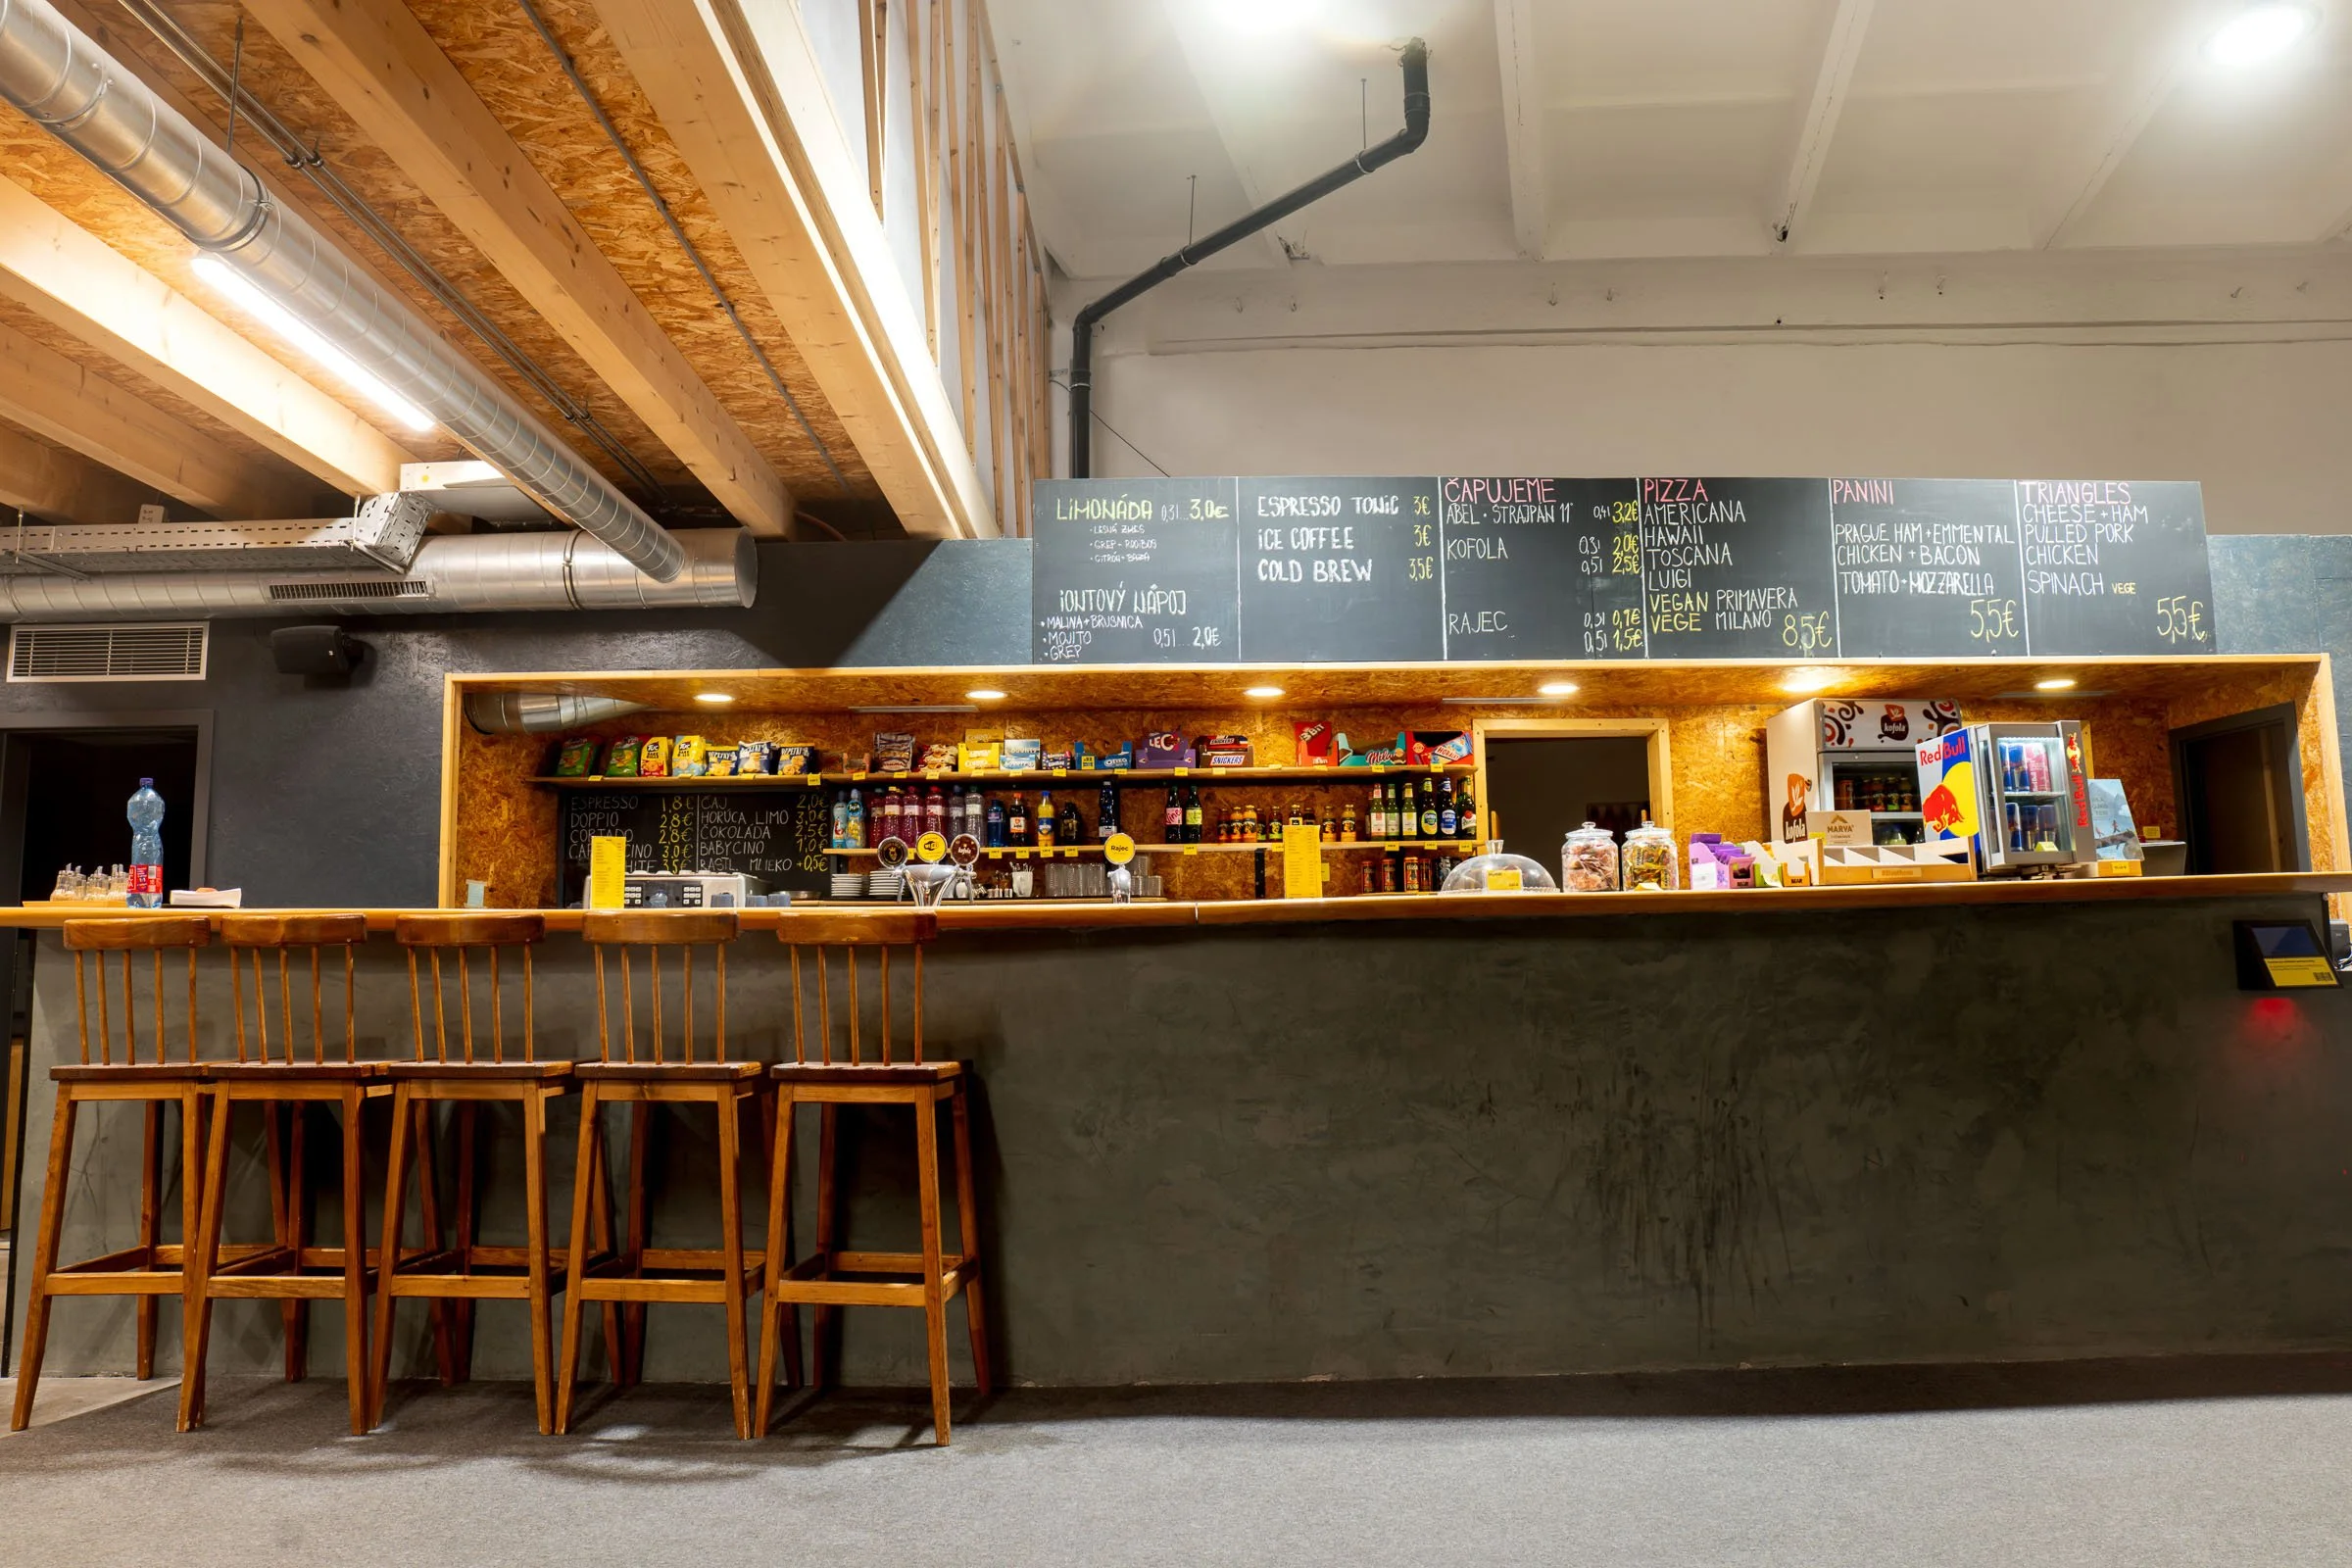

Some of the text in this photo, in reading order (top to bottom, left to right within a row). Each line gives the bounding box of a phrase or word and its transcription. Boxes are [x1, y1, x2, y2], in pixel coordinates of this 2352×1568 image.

[1445, 478, 1557, 504] ČAPUJEME
[1644, 479, 1708, 503] PIZZA
[1833, 480, 1893, 505] PANINI
[2019, 481, 2131, 505] TRIANGLES
[1258, 496, 1341, 516] ESPRESSO
[1413, 496, 1431, 515] 3€
[1644, 500, 1746, 525] AMERICANA
[2023, 504, 2096, 524] CHEESE
[2111, 505, 2149, 524] HAM
[1291, 527, 1354, 550] COFFEE
[1414, 525, 1432, 548] 3€
[1644, 525, 1703, 548] HAWAII
[1836, 523, 1889, 545] PRAGUE
[1894, 523, 1923, 543] HAM
[2026, 523, 2134, 545] PULLED PORK
[1447, 537, 1508, 560] KOFOLA
[1646, 542, 1733, 570] TOSCANA
[1838, 545, 1902, 565] CHICKEN
[1921, 545, 1981, 565] BACON
[2026, 544, 2098, 565] CHICKEN
[1258, 559, 1302, 582] COLD
[1313, 559, 1373, 582] BREW
[1649, 568, 1691, 591] LUIGI
[1839, 570, 1899, 595] TOMATO
[1909, 570, 1994, 596] MOZZARELLA
[2027, 569, 2136, 596] SPINACH VEGE
[1134, 584, 1187, 615] NÁPOJ
[1649, 587, 1798, 612] VEGAN PRIMAVERA
[1448, 612, 1508, 635] RAJEC
[1650, 610, 1772, 634] VEGE MILANO
[1971, 599, 2019, 643] 5,5€
[2157, 595, 2206, 644] 5,5€
[1049, 631, 1092, 646] MOJITO
[1051, 645, 1082, 660] GREP
[1884, 723, 1906, 733] kofola
[1212, 756, 1244, 765] SNICKERS
[1920, 735, 1966, 765] Red Bull
[571, 796, 639, 811] ESPRESSO
[701, 795, 727, 809] ČAJ
[2072, 774, 2089, 827] Red Bull
[570, 811, 619, 829] DOPPIO
[701, 809, 747, 824] HORÚCA
[756, 809, 789, 824] LIMO
[701, 824, 771, 840] ČOKOLÁDA
[1786, 817, 1805, 843] kofola
[750, 858, 793, 872] MLIEKO
